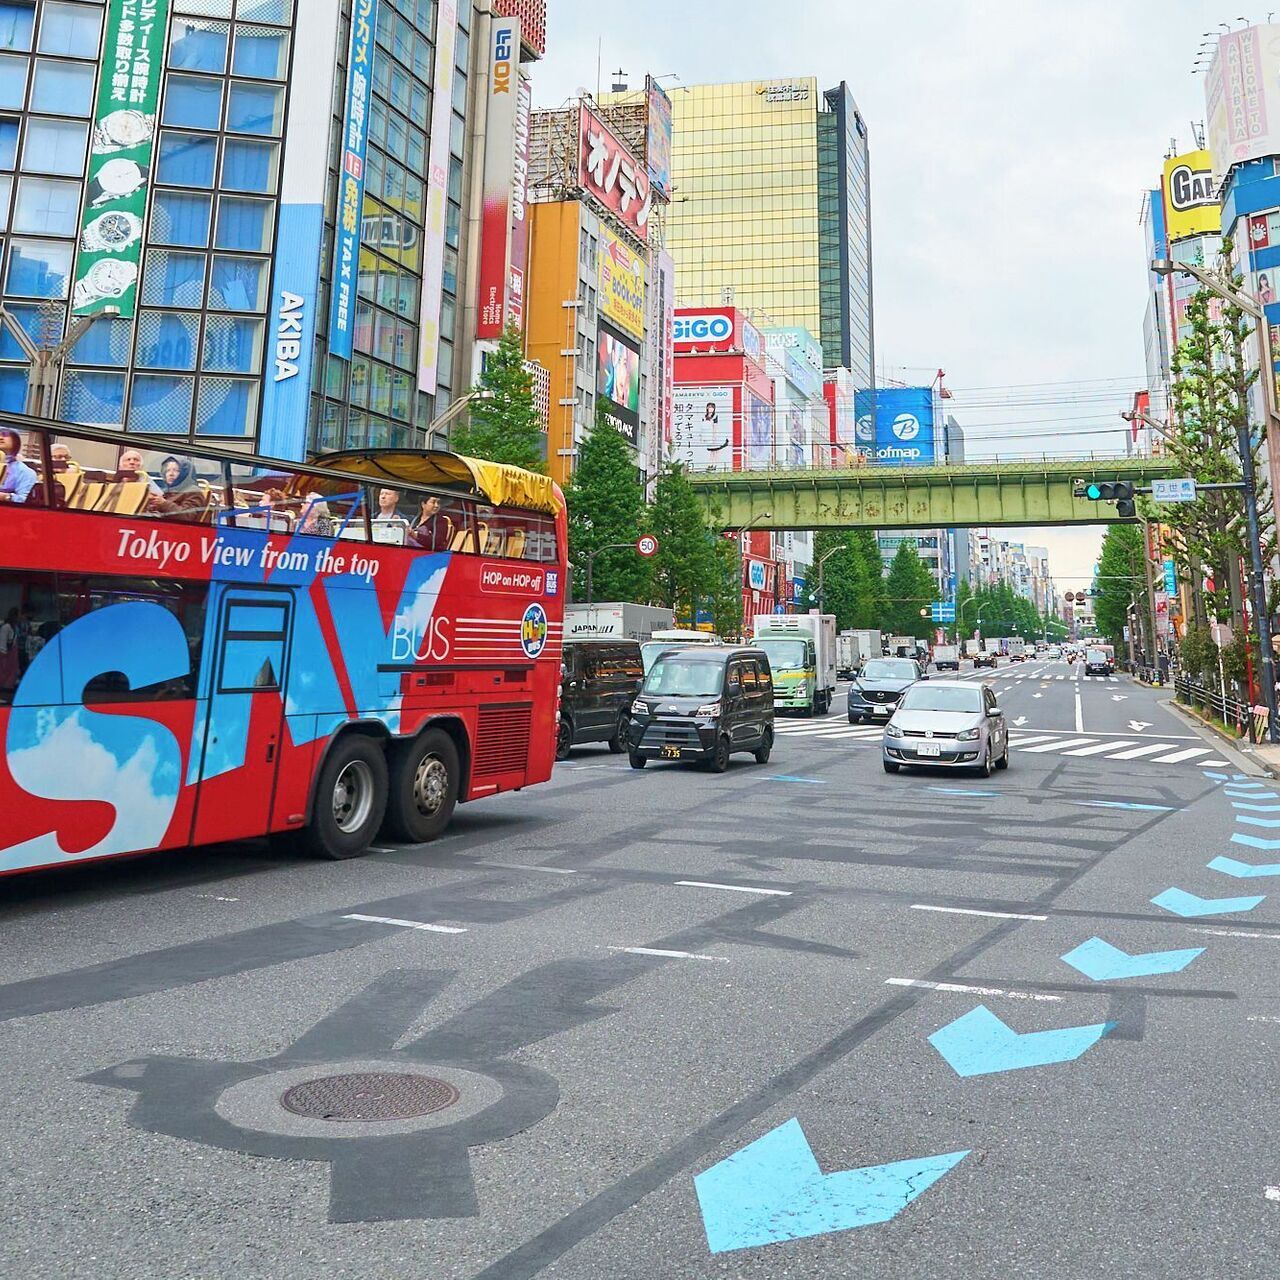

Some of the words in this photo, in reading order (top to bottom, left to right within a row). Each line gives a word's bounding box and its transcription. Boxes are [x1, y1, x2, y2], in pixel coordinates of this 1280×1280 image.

[1228, 43, 1246, 138] AKIHABARA
[1241, 32, 1258, 106] WELCOME
[1250, 113, 1260, 134] TO
[347, 152, 360, 177] 1F
[587, 130, 652, 226] オノデン
[342, 177, 360, 235] 免税
[338, 236, 352, 282] TAX
[336, 282, 349, 332] FREE
[489, 286, 497, 325] Electronics
[274, 290, 306, 382] AKIBA
[673, 318, 730, 340] GiGO
[1155, 482, 1192, 493] 万世橋
[117, 528, 191, 569] Tokyo
[200, 536, 253, 567] View
[260, 541, 307, 572] from
[315, 547, 345, 575] the
[350, 554, 380, 583] top
[641, 540, 653, 551] 50
[483, 571, 502, 585] HOP
[502, 575, 512, 585] on
[512, 573, 530, 587] HOP
[530, 575, 542, 592] off
[546, 573, 558, 581] SKY
[392, 616, 450, 661] BUS
[527, 641, 542, 653] BUS
[572, 624, 599, 634] JAPAN
